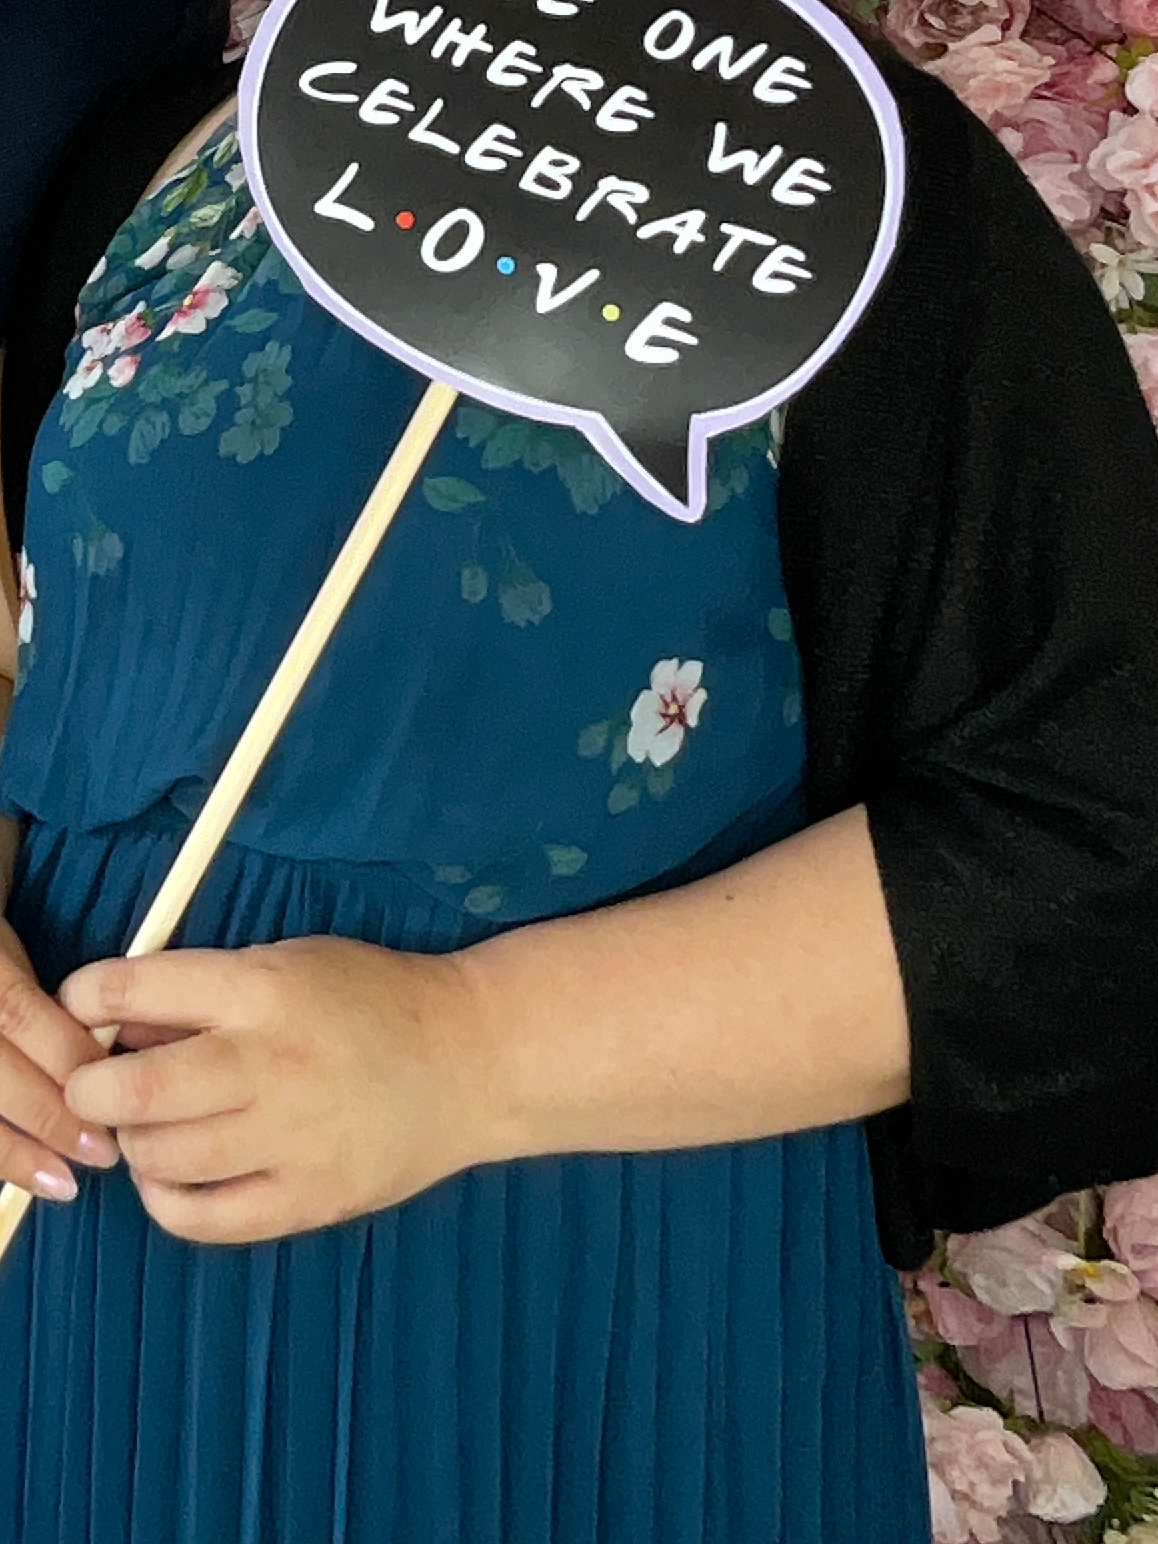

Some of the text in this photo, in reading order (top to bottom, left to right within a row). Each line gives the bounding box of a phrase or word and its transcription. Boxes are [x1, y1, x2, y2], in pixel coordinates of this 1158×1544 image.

[642, 9, 814, 105] ONE
[297, 60, 814, 295] CELEBRATE
[704, 120, 834, 207] WE
